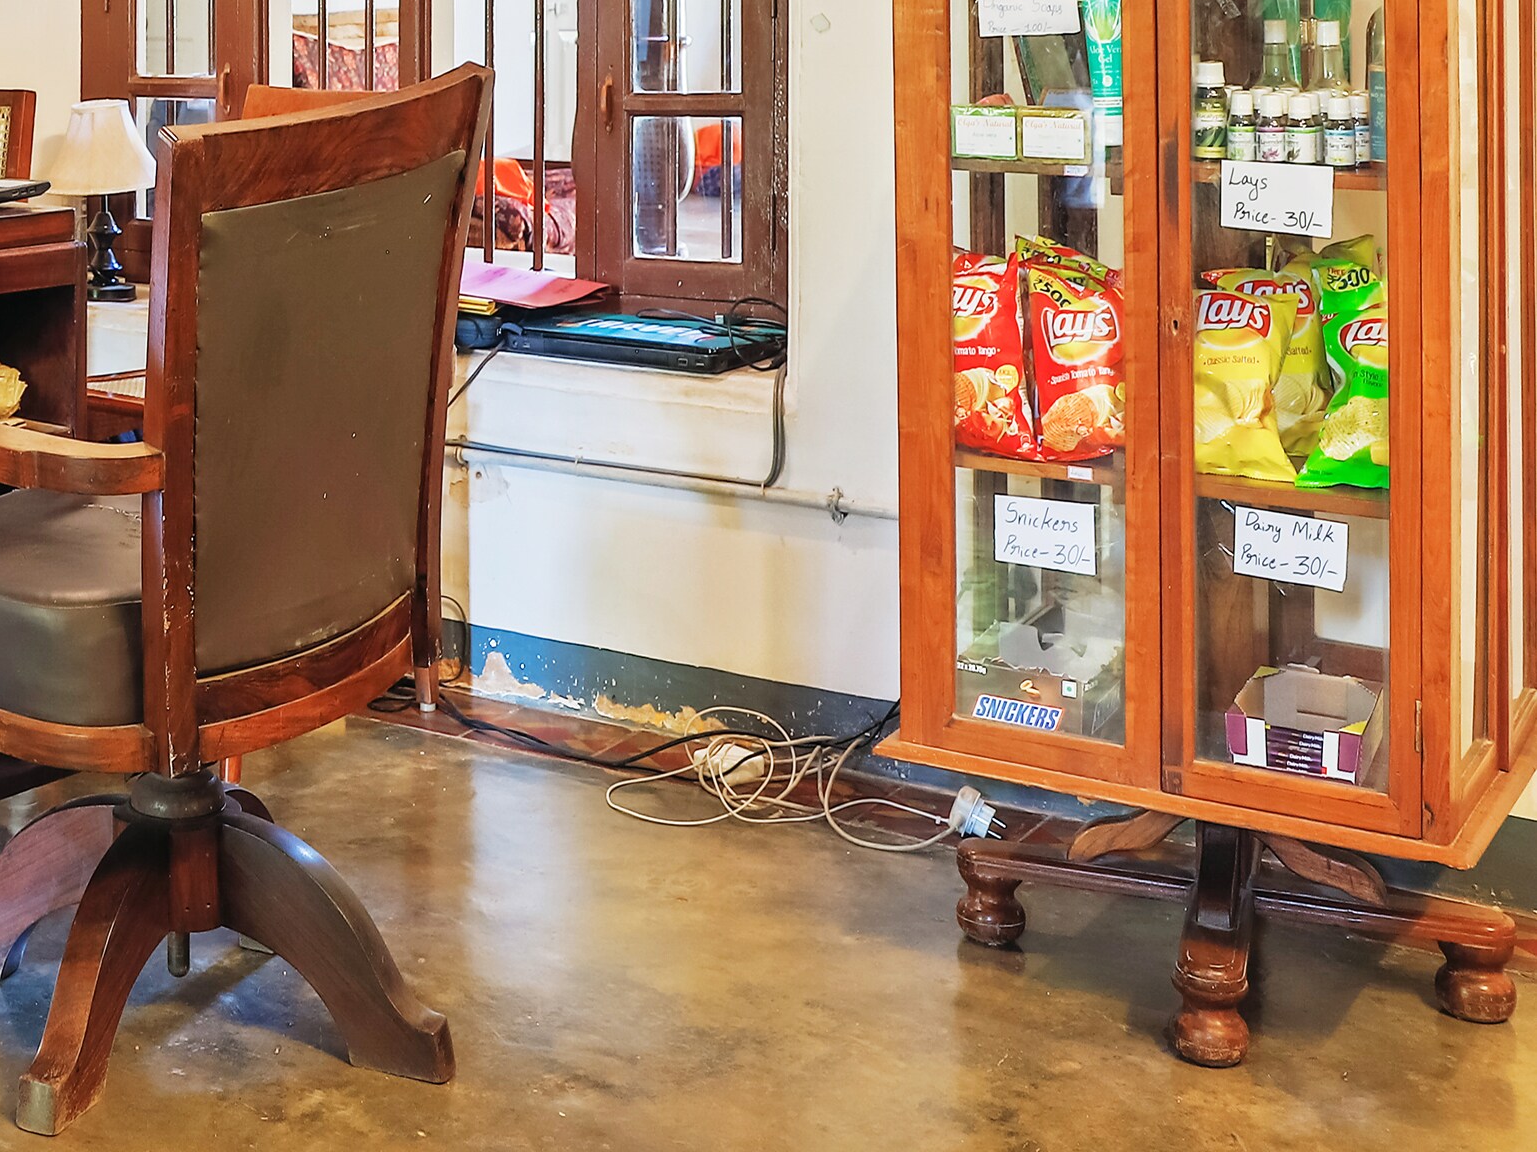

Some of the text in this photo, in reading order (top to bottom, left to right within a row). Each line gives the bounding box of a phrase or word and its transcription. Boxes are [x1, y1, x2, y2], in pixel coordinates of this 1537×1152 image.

[1229, 167, 1268, 201] Lays
[1283, 211, 1323, 232] 30/-
[978, 345, 996, 358] Tango
[1071, 367, 1096, 379] Tomato
[1004, 501, 1078, 533] Snickers
[1245, 511, 1335, 543] Dairy Milk
[1053, 544, 1090, 565] 30/-
[1292, 556, 1337, 579] 30/-
[976, 696, 1059, 731] SNICKERS
